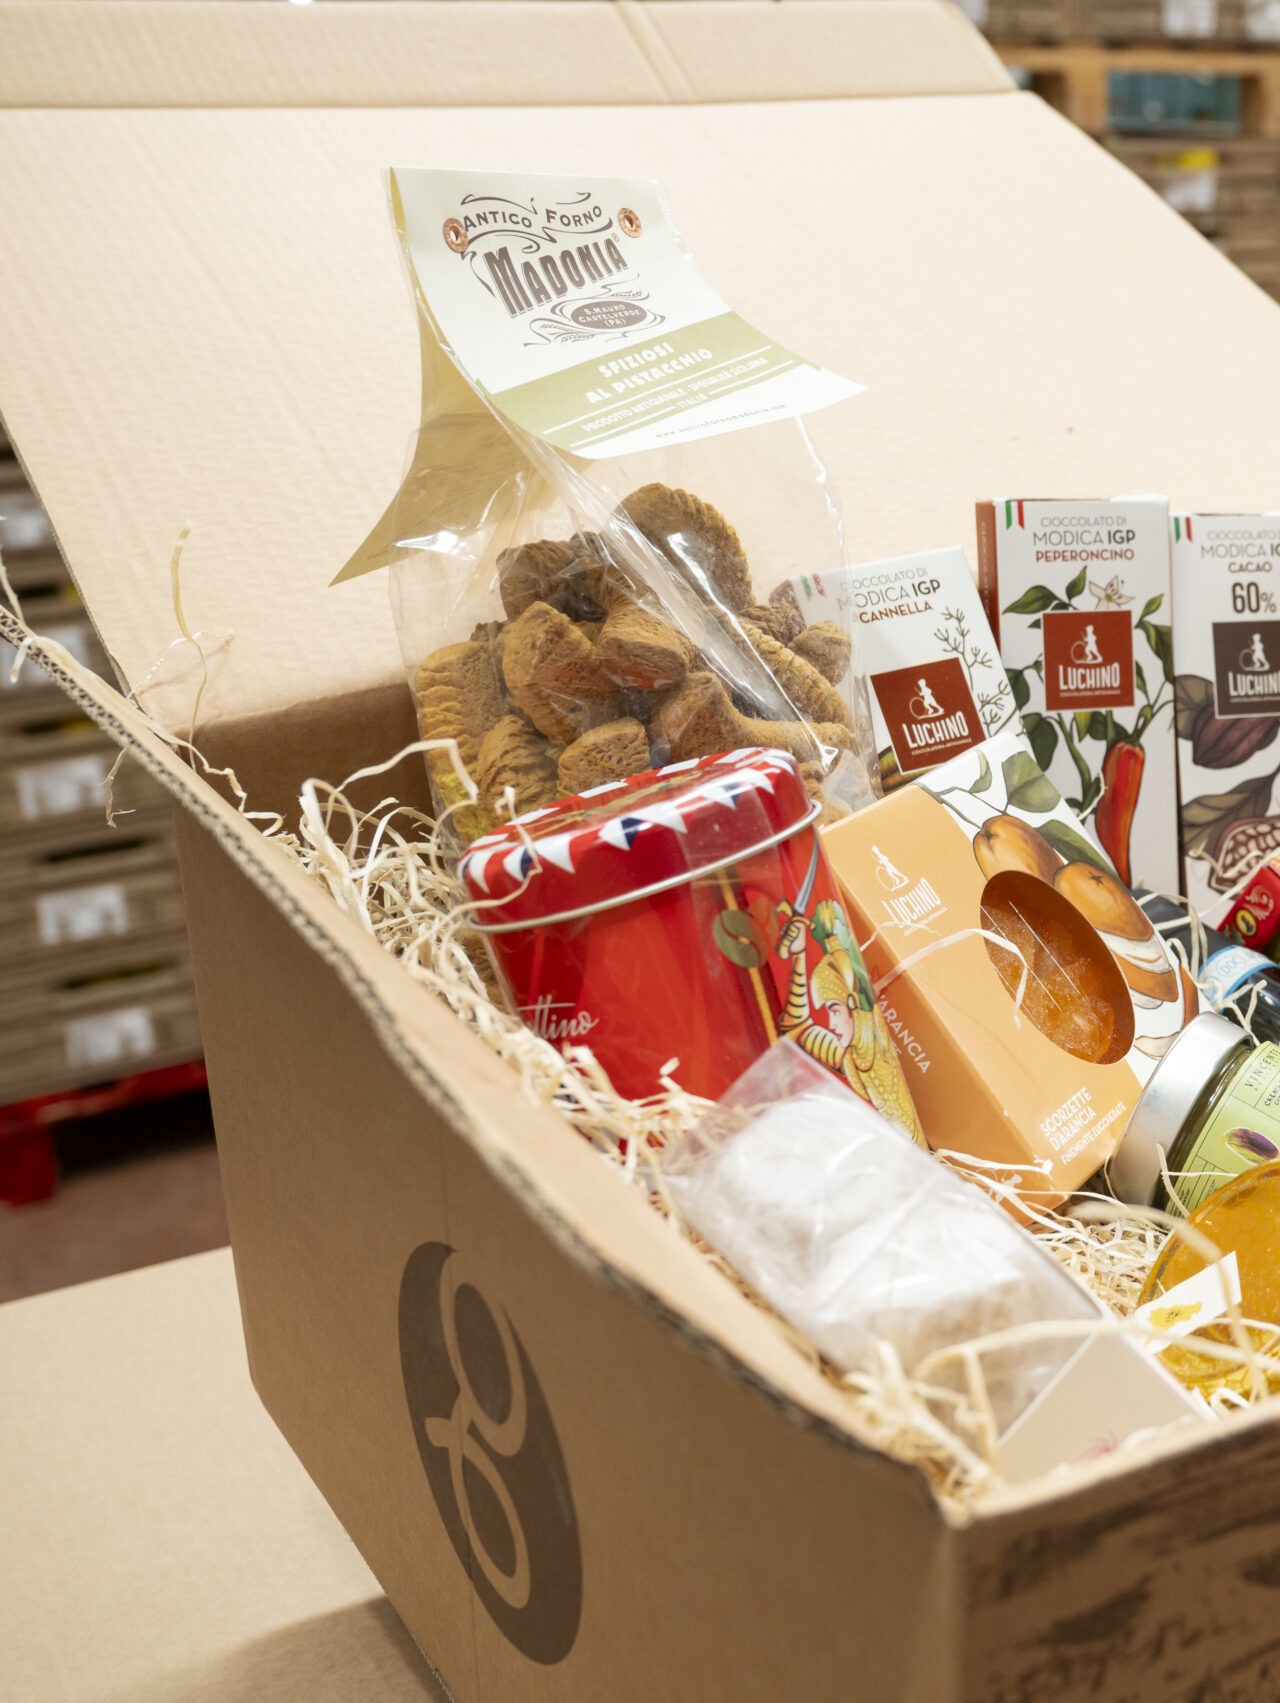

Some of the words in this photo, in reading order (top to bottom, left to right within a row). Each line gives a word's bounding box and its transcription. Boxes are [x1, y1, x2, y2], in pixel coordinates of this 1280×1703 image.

[463, 210, 533, 232] ANTICO
[545, 205, 602, 227] FORNO
[483, 238, 630, 318] MADONIA
[578, 309, 641, 323] CASTELVERDE
[605, 318, 627, 327] (PA)
[597, 341, 675, 379] SFIZIOSI
[584, 388, 613, 404] AL
[610, 348, 713, 394] PISTACCHIO
[581, 409, 633, 433] PRODOTTO
[1041, 516, 1115, 528] CIOCCOLATO
[1116, 516, 1127, 526] DI
[1207, 530, 1276, 541] CIOCCOLATO
[1033, 530, 1104, 547] MODICA
[1108, 529, 1136, 545] IGP
[1200, 544, 1268, 559] MODICA
[1035, 548, 1134, 563] PEPERONCINO
[1228, 561, 1272, 574] CACAO
[853, 568, 915, 590] OCCOLATO
[916, 568, 929, 578] DI
[854, 585, 911, 608] ODICA
[912, 579, 941, 597] IGP
[1232, 582, 1277, 614] 60%
[859, 600, 933, 624] CANNELLA
[1059, 662, 1120, 690] LUCHINO
[902, 711, 969, 749] LUCHINO
[881, 877, 941, 928] LUCHINO
[516, 994, 599, 1039] ttino
[878, 994, 931, 1074] 'ARANCIA
[1040, 1087, 1092, 1137] SCORZETTE
[1048, 1105, 1097, 1151] D'ARANCIA
